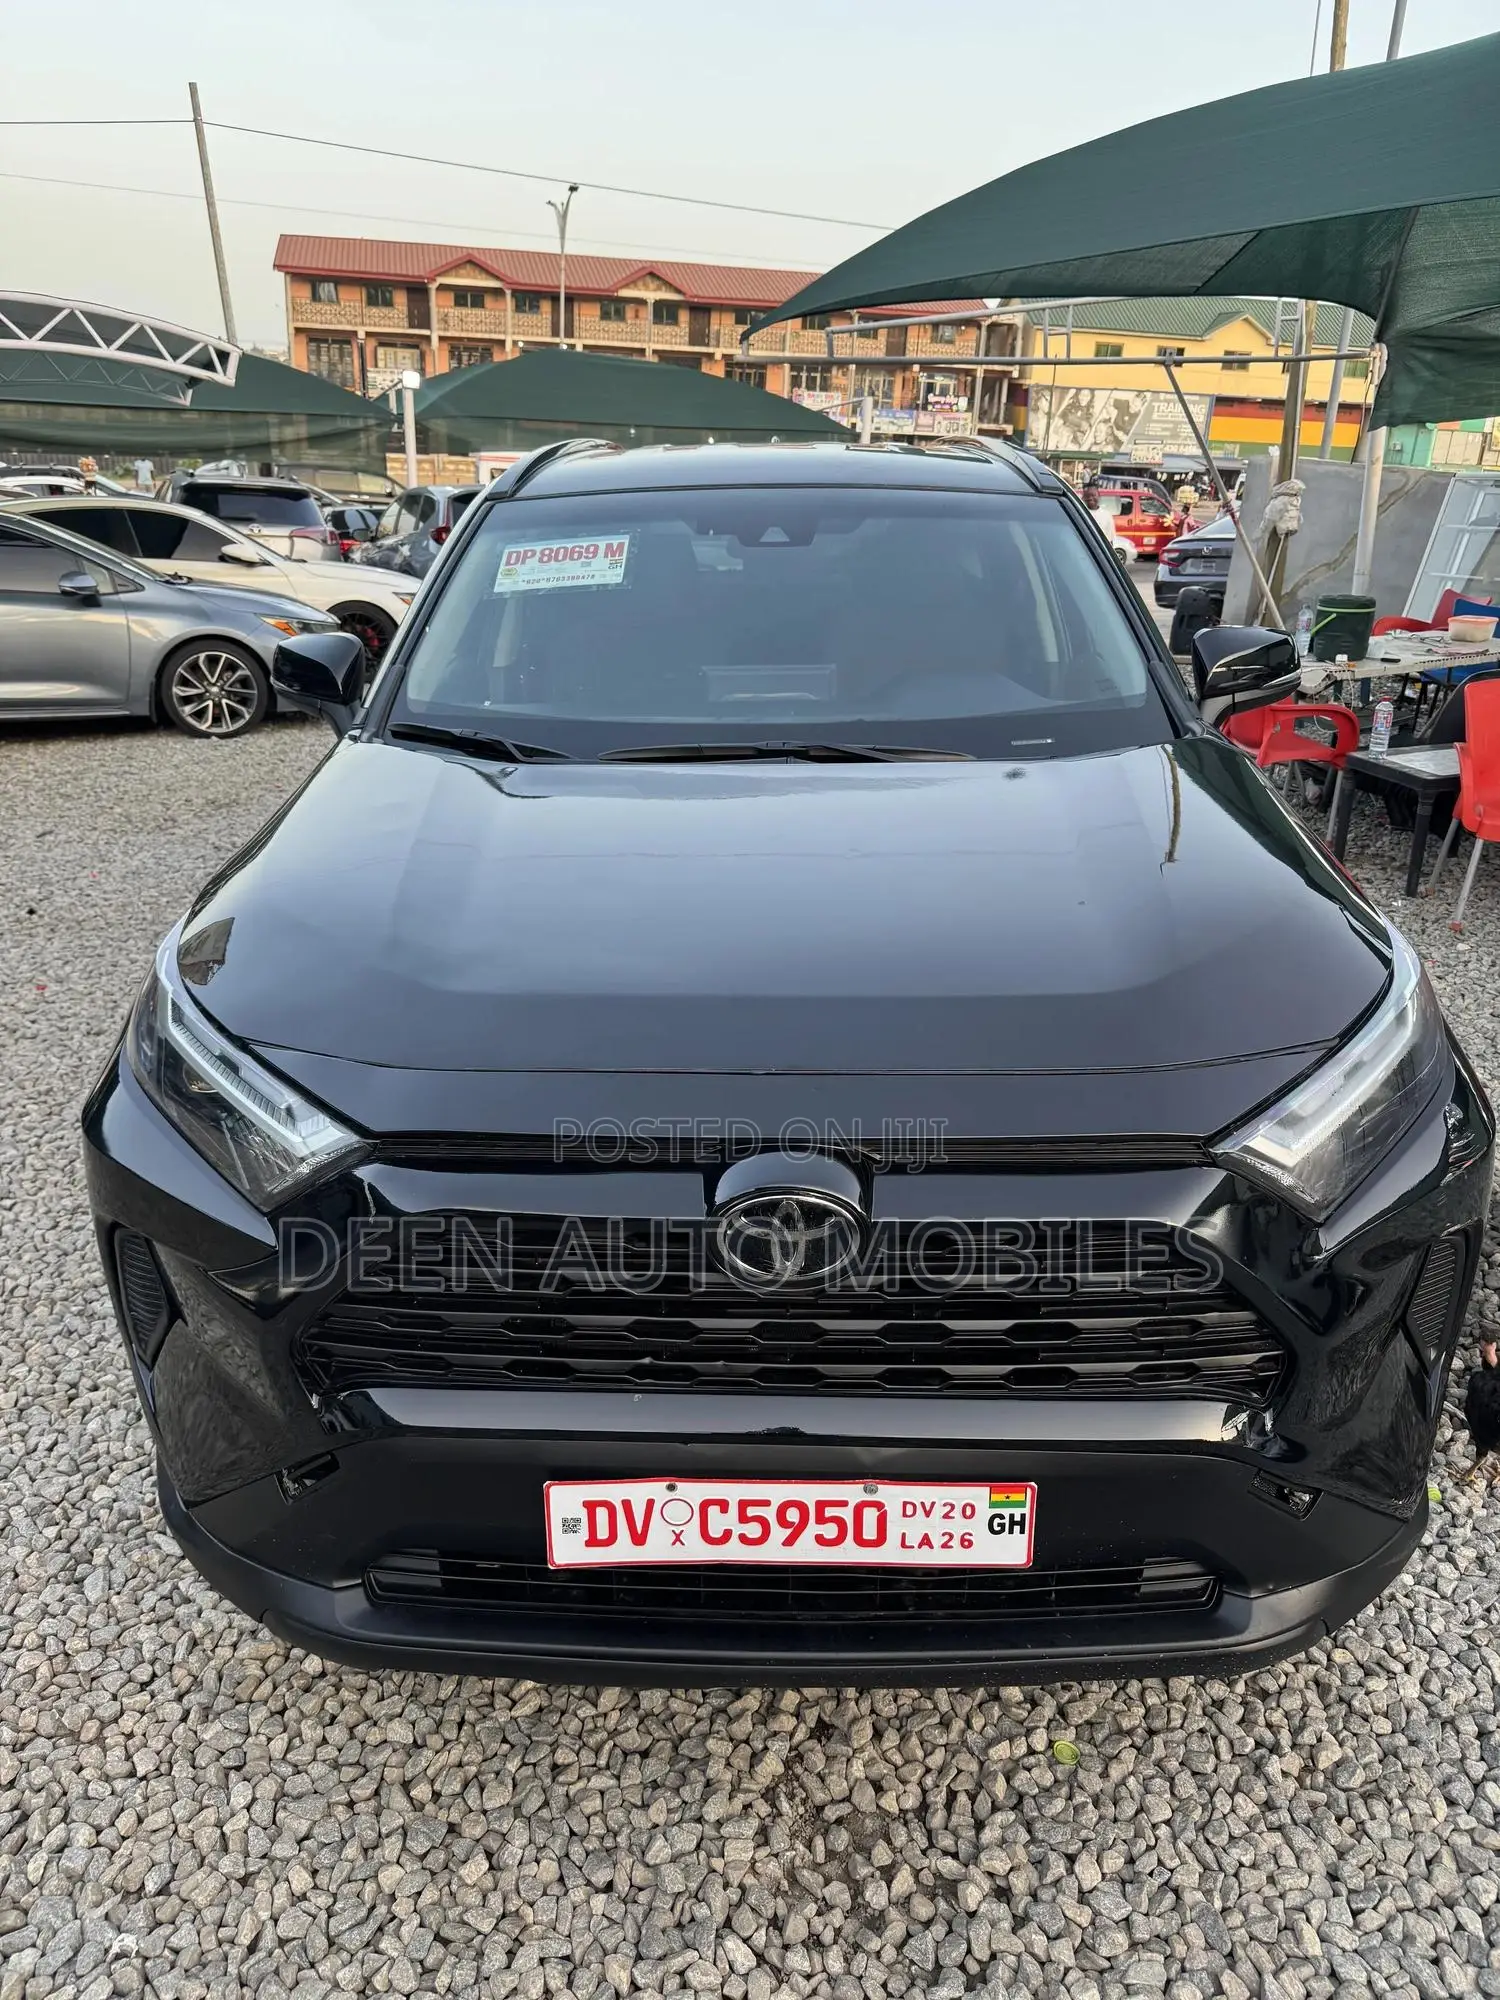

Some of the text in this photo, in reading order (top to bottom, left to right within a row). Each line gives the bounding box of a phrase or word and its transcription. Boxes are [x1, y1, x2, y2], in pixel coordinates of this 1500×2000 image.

[1152, 402, 1205, 415] TRAINNG
[604, 541, 625, 559] M
[582, 1498, 888, 1548] DV C5950
[987, 1513, 1027, 1536] GH
